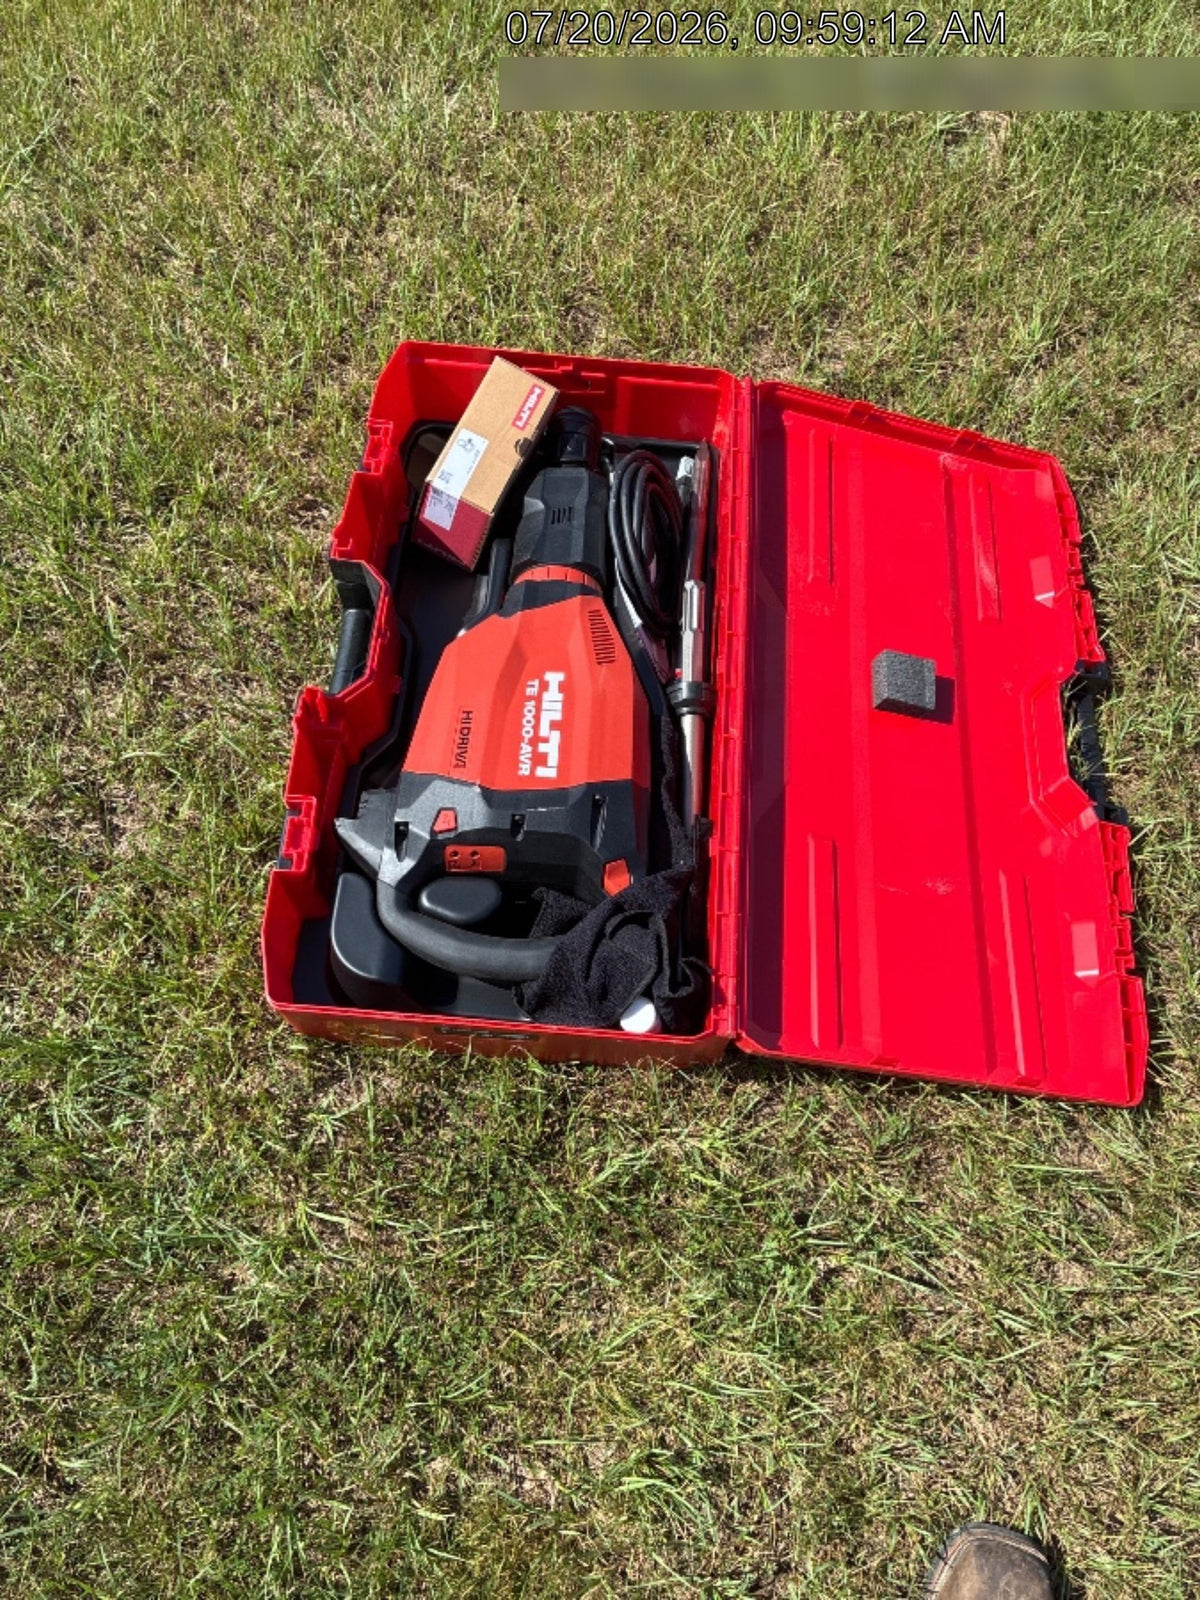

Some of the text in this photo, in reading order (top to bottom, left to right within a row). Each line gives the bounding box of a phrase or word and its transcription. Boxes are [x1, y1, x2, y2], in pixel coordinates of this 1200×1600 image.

[514, 385, 543, 429] HILTI
[517, 679, 540, 776] TE 1000-AVR
[535, 671, 565, 778] HILTI
